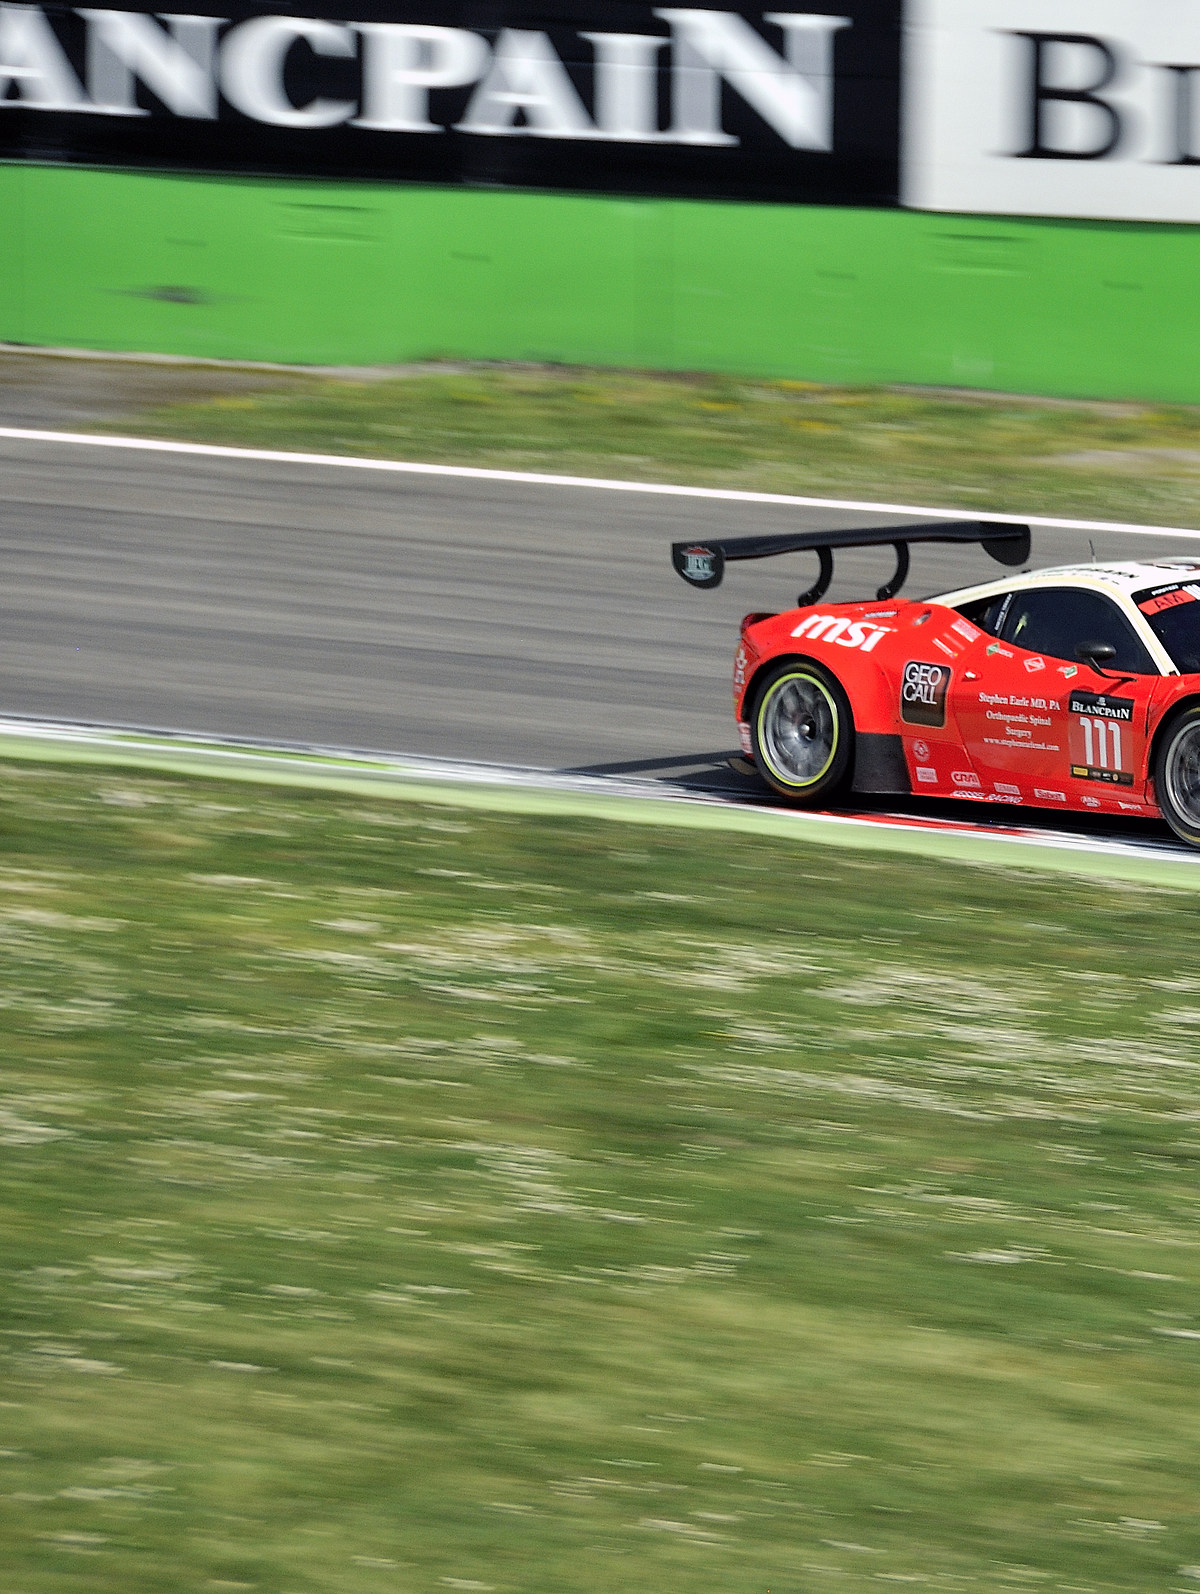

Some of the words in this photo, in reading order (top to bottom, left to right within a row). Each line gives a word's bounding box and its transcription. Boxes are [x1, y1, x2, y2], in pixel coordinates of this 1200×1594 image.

[905, 663, 942, 686] GEO
[903, 682, 938, 705] CALL
[1049, 700, 1061, 711] PA
[1072, 700, 1130, 720] BLANCPAIN
[1005, 726, 1032, 739] Surgery
[1079, 716, 1122, 771] 111
